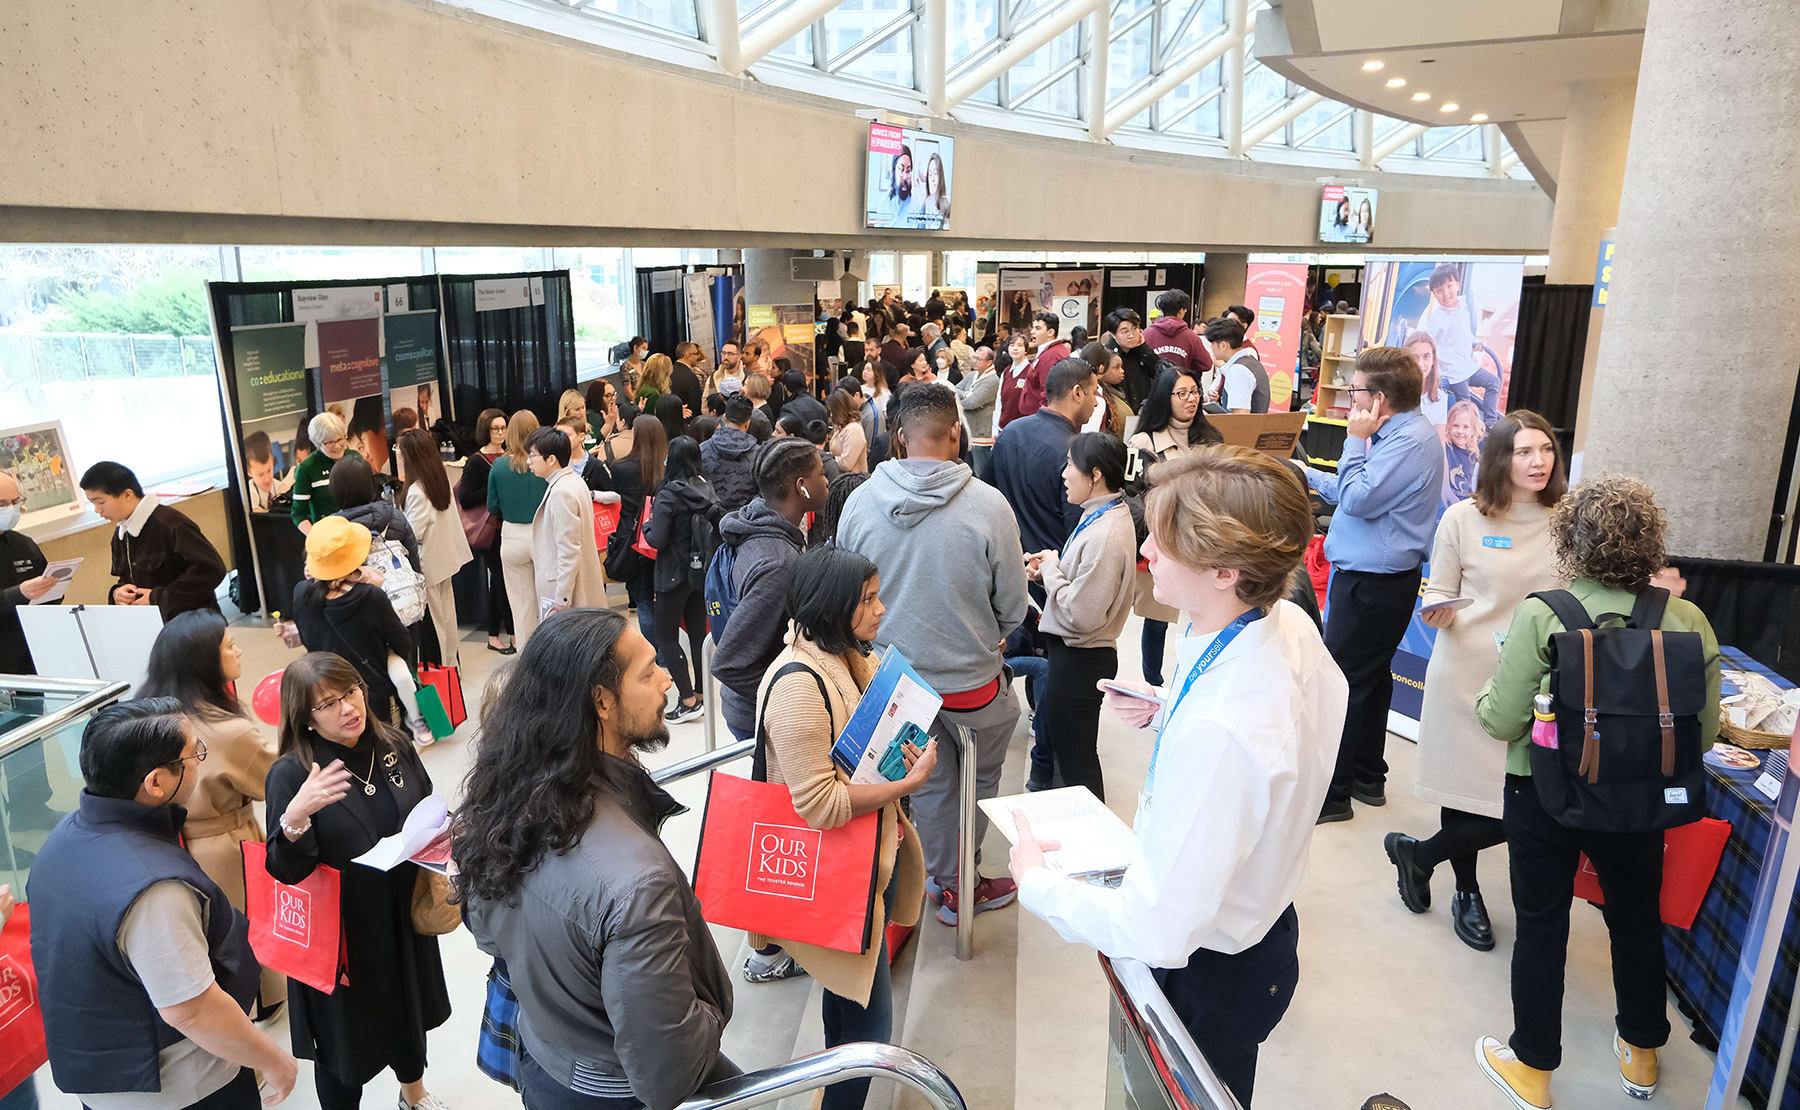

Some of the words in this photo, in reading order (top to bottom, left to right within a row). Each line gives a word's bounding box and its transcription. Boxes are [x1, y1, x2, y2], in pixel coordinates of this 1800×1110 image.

[872, 127, 888, 137] ADVICE
[889, 131, 901, 139] FROM
[395, 297, 404, 307] 66
[1196, 638, 1224, 673] yourself
[1391, 670, 1425, 691] soncoll
[761, 834, 808, 858] OUR
[759, 853, 808, 878] KIDS
[767, 877, 787, 885] TRUSTED
[280, 890, 306, 913] OUR
[280, 905, 306, 929] KIDS
